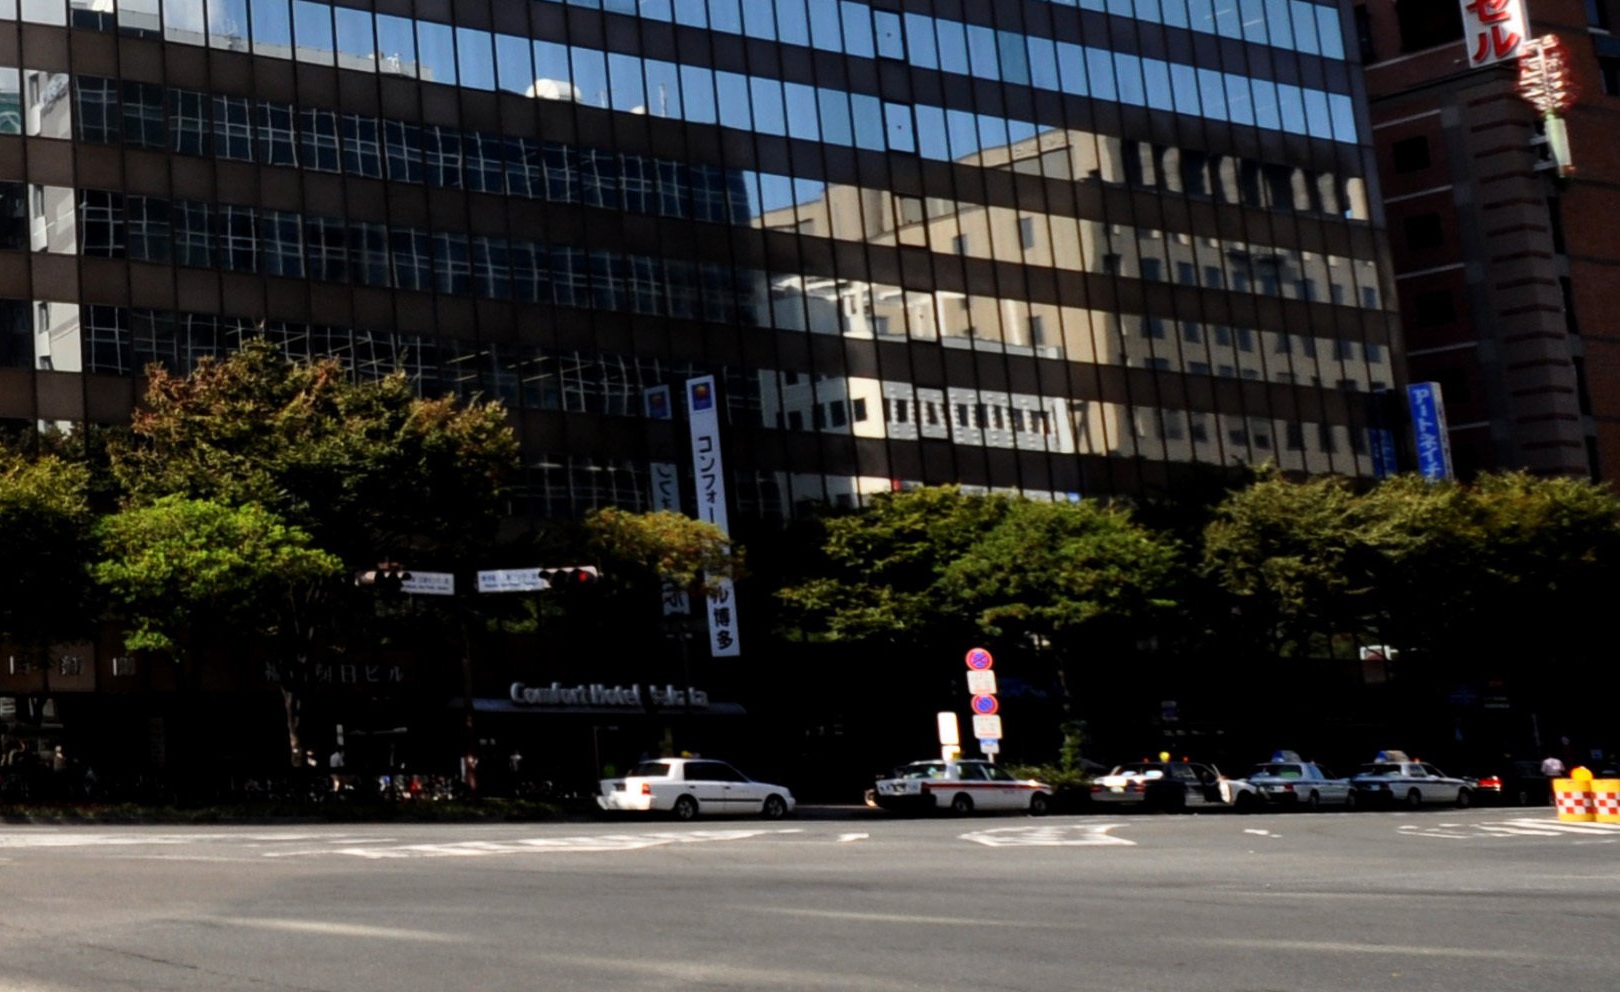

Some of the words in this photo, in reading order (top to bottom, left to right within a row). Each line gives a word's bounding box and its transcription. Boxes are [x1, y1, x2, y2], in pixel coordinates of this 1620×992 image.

[698, 436, 734, 651] コンフォール博多
[509, 681, 588, 705] Comfort
